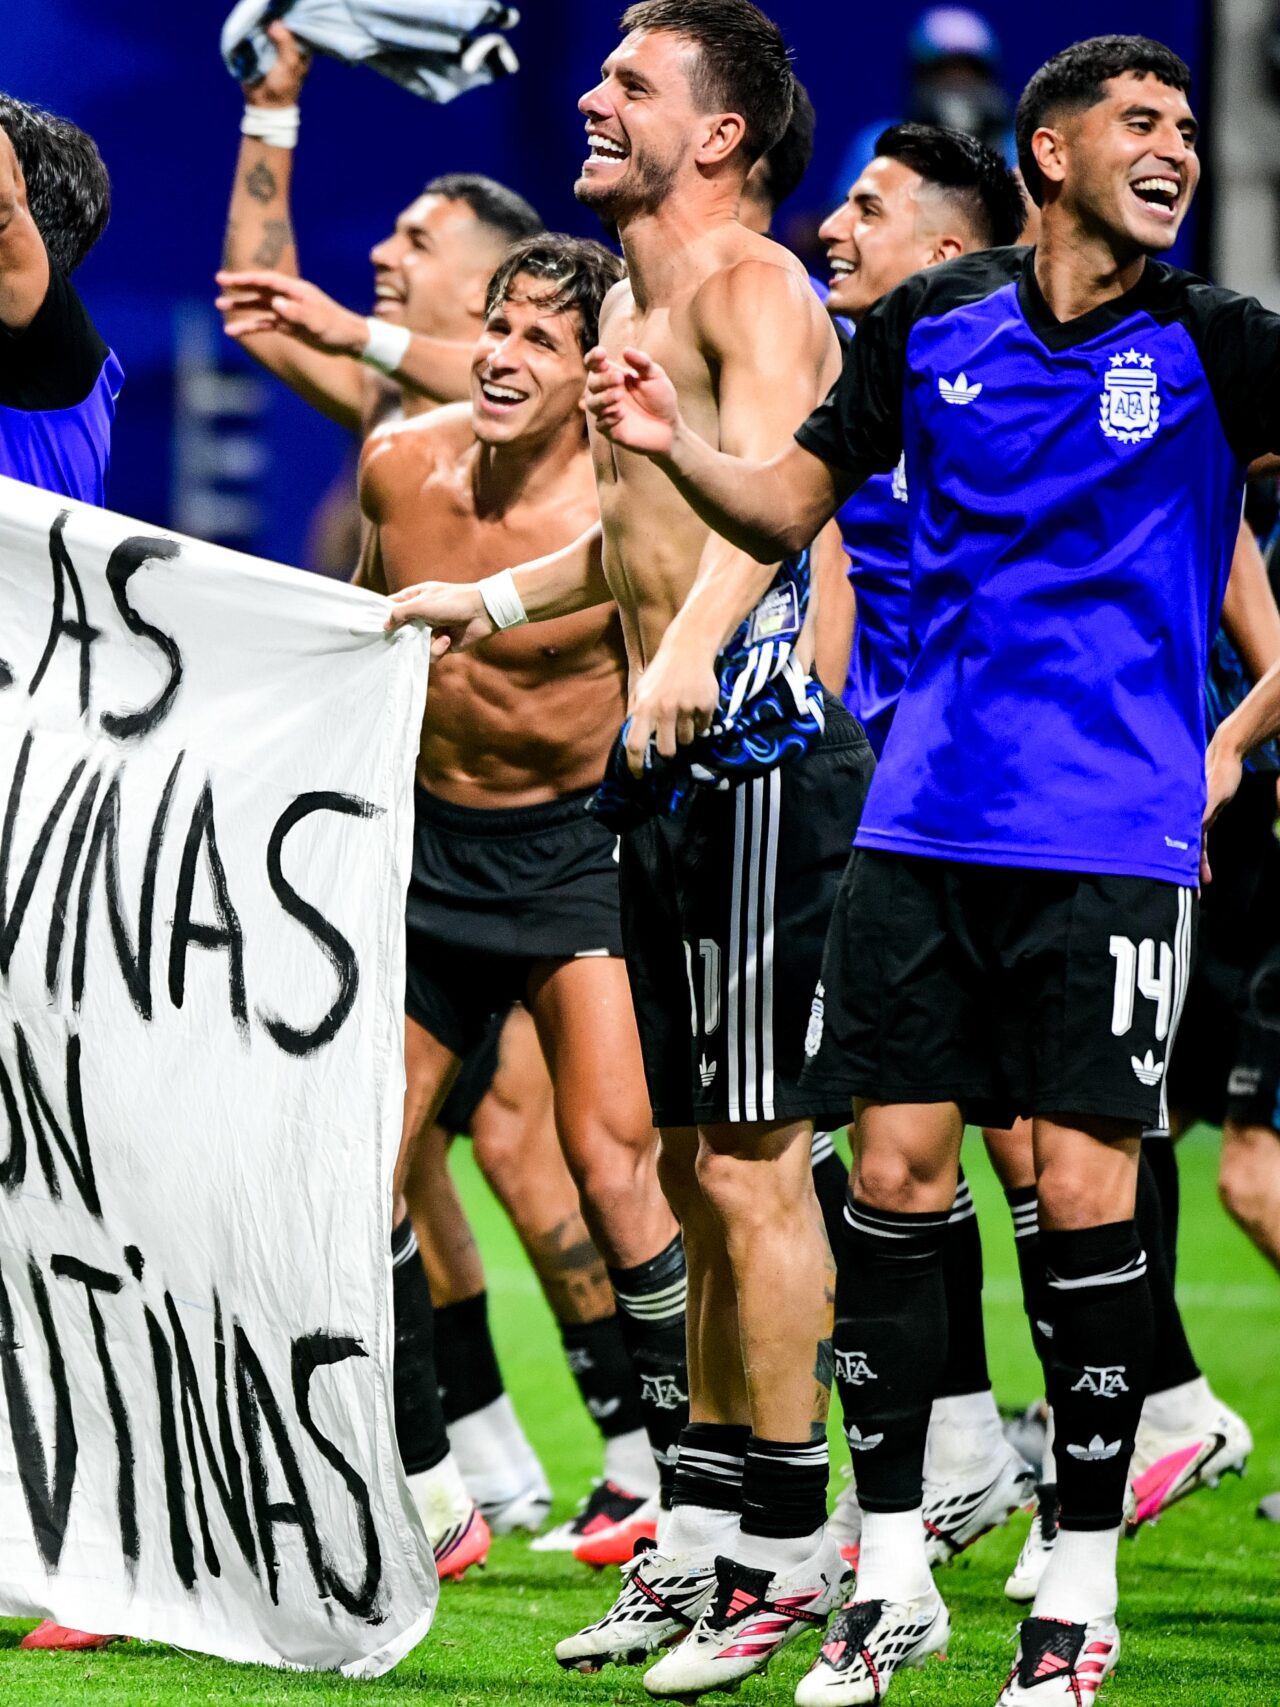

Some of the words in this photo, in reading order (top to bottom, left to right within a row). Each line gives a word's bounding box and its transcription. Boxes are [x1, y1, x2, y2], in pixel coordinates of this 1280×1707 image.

[1109, 935, 1173, 1041] 14
[834, 1349, 878, 1386] AFA
[1071, 1366, 1129, 1398] AFA
[640, 1374, 688, 1410] AFA
